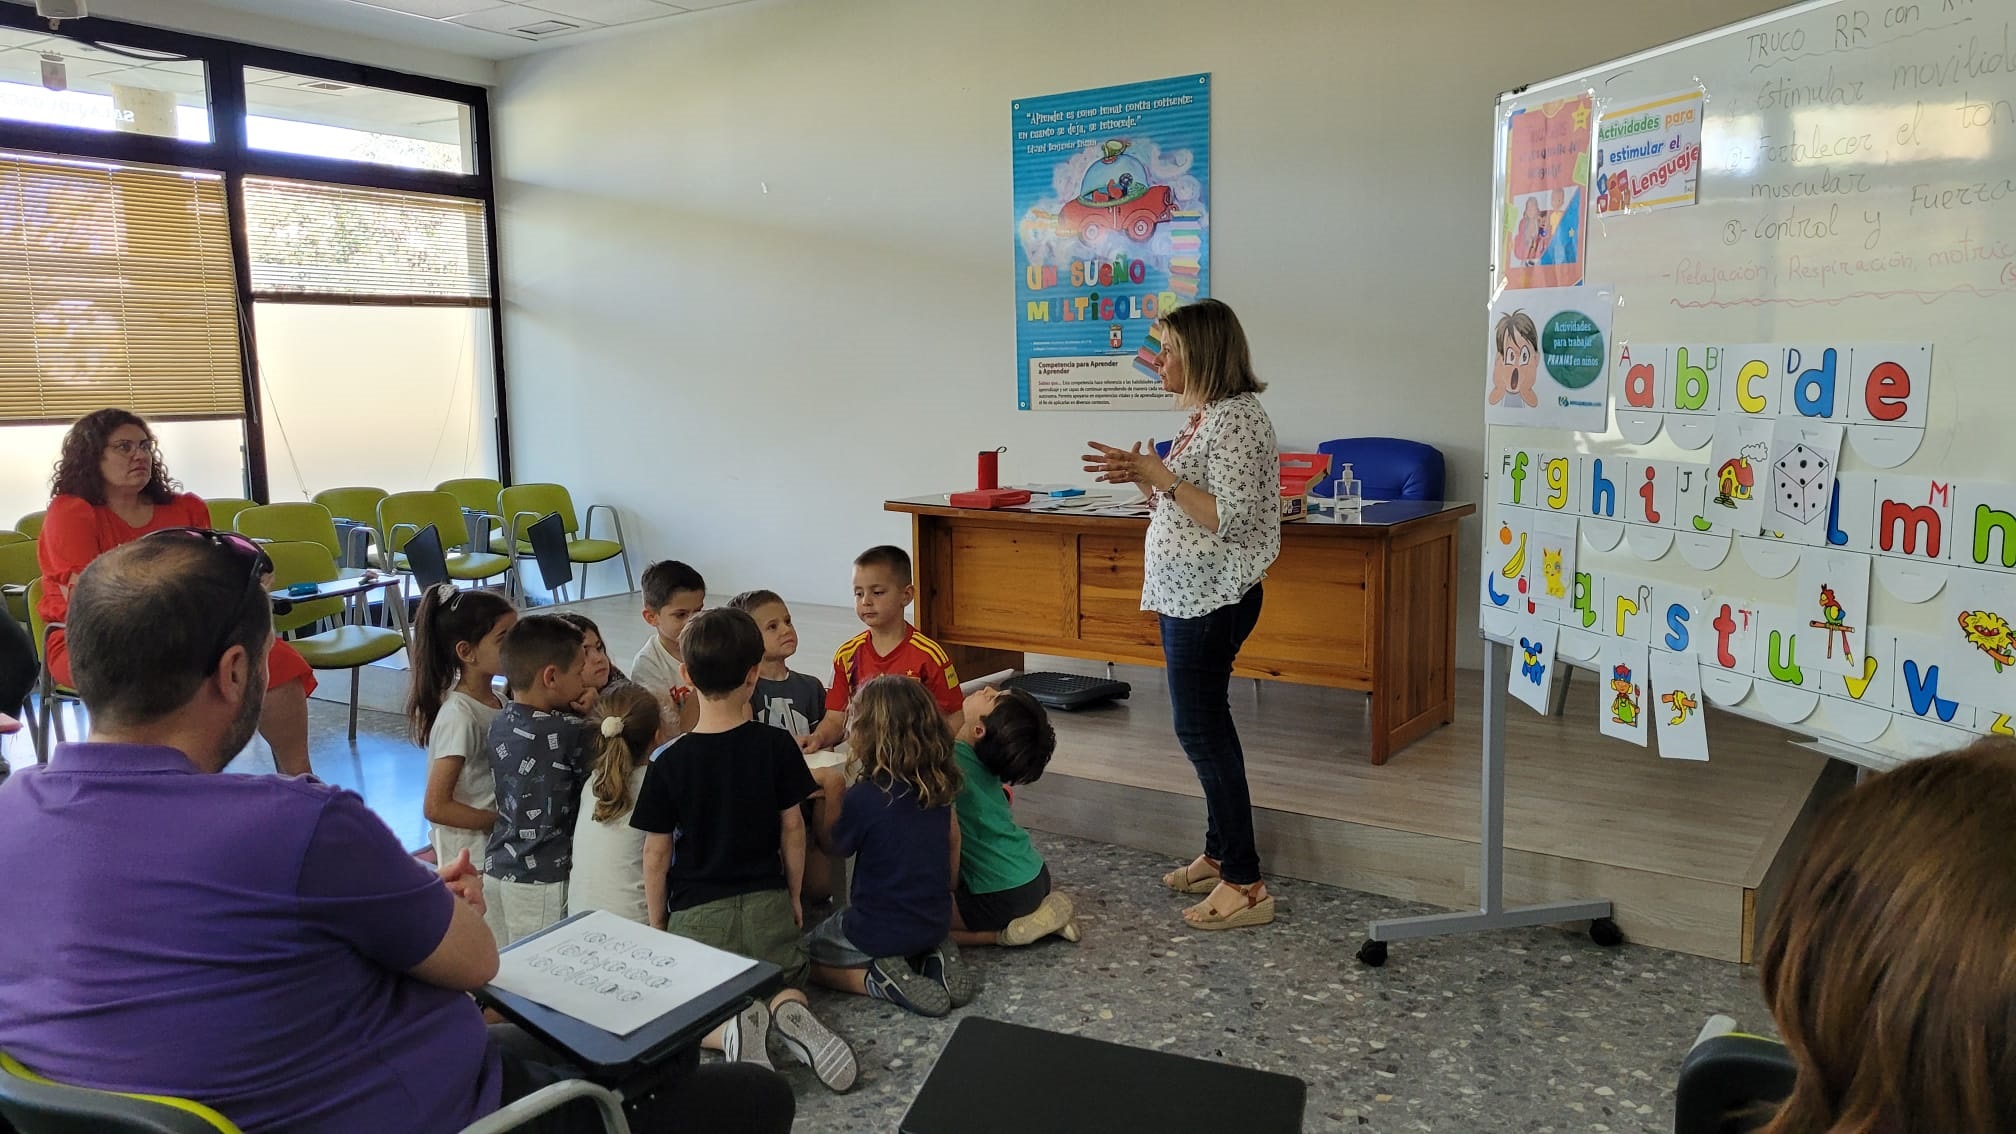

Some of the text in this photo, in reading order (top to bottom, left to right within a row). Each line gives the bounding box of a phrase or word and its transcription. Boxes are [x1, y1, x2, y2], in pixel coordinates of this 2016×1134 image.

[1746, 29, 1805, 61] TRUCO
[1835, 10, 1870, 49] RR
[1883, 4, 1920, 29] con
[1599, 115, 1661, 140] Actividades
[1665, 109, 1694, 130] para
[1896, 100, 1922, 146] el
[1610, 134, 1680, 163] estimular el
[1631, 146, 1700, 195] Lenguaje
[1750, 168, 1870, 198] muscular
[1864, 210, 1881, 250] y
[1027, 265, 1057, 290] UN
[1554, 321, 1592, 333] Actividades
[1553, 336, 1593, 350] para trabajar
[1038, 361, 1075, 369] Competencia
[1090, 360, 1118, 368] Aprender
[1043, 368, 1070, 376] Aprender
[1547, 354, 1599, 367] PRAXIAS en niños
[1619, 345, 1801, 374] A B D
[1625, 346, 1911, 422] a b c d e
[1502, 455, 1511, 476] F
[1681, 471, 1693, 493] J
[1929, 480, 1949, 508] M
[1511, 451, 1530, 505] f
[1547, 457, 1569, 510] g
[1592, 458, 1616, 518] h
[1639, 466, 1661, 524] i
[1880, 499, 1942, 559] m
[1973, 503, 2016, 568] n
[1638, 584, 1753, 633] R T
[1615, 595, 1639, 638] r
[1665, 603, 1691, 653] s
[1713, 603, 1738, 670] t
[1768, 630, 1804, 687] u
